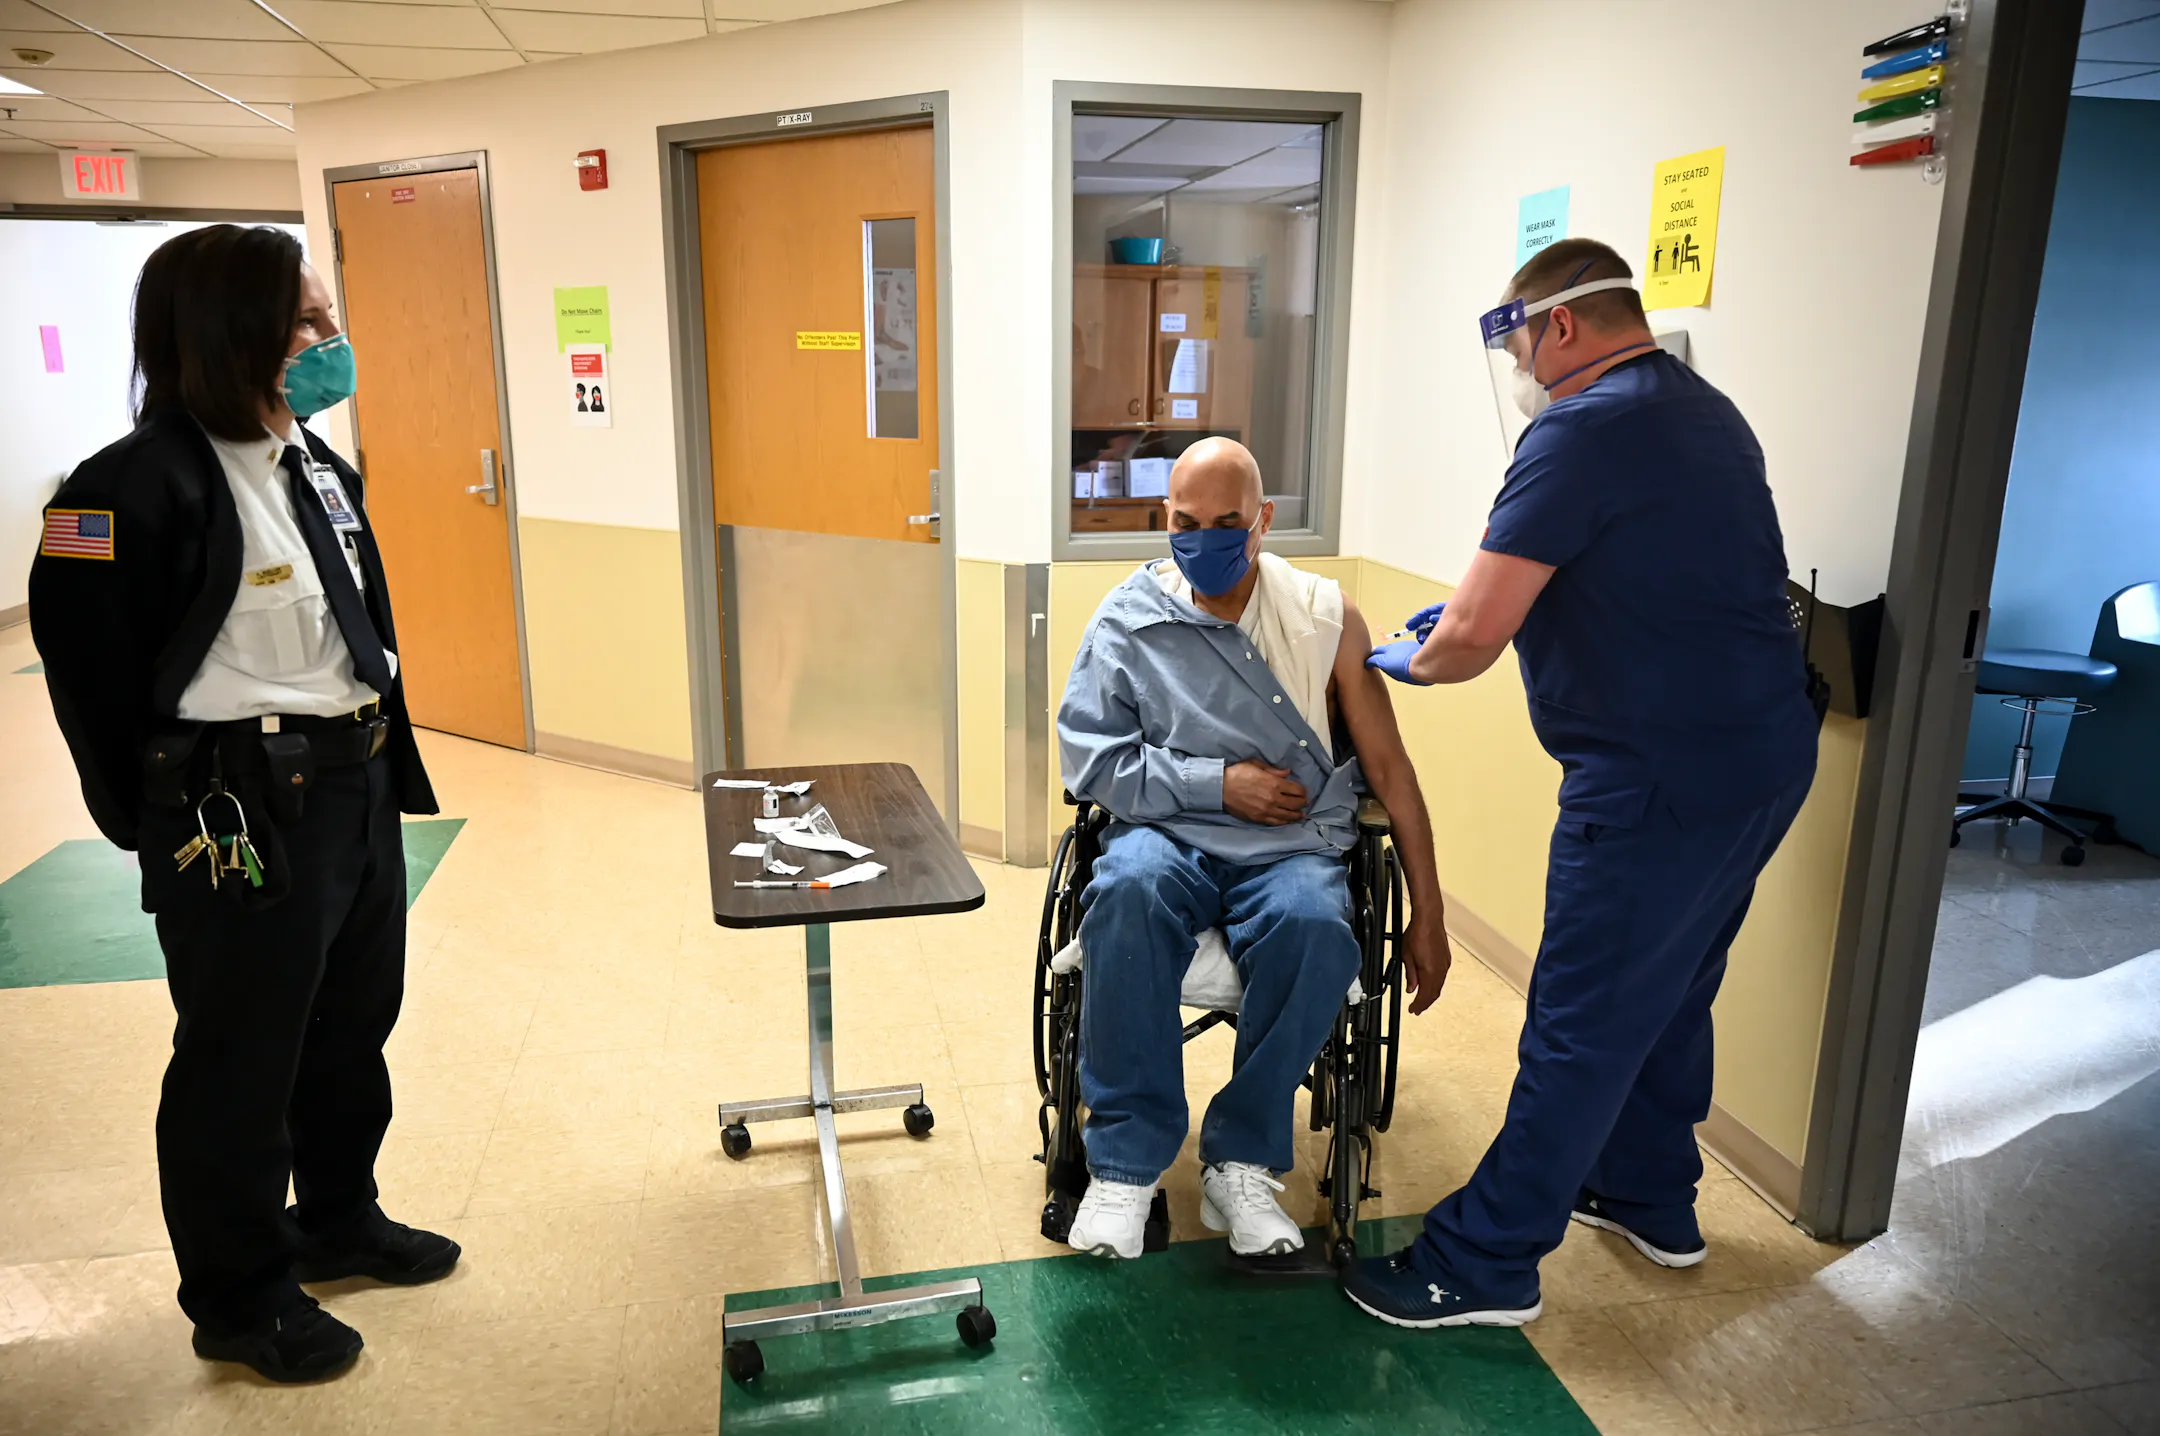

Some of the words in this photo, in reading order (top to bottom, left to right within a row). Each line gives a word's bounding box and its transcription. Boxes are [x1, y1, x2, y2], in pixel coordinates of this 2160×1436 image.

[74, 156, 126, 194] EXIT
[380, 164, 400, 172] JANITOR
[1664, 173, 1681, 185] STAY
[1682, 166, 1709, 181] SEATED
[1671, 199, 1694, 212] SOCIAL
[1526, 222, 1540, 233] WEAR
[1541, 219, 1556, 229] MASK
[1665, 216, 1697, 231] DISTANCE
[1526, 235, 1553, 248] CORRECTLY
